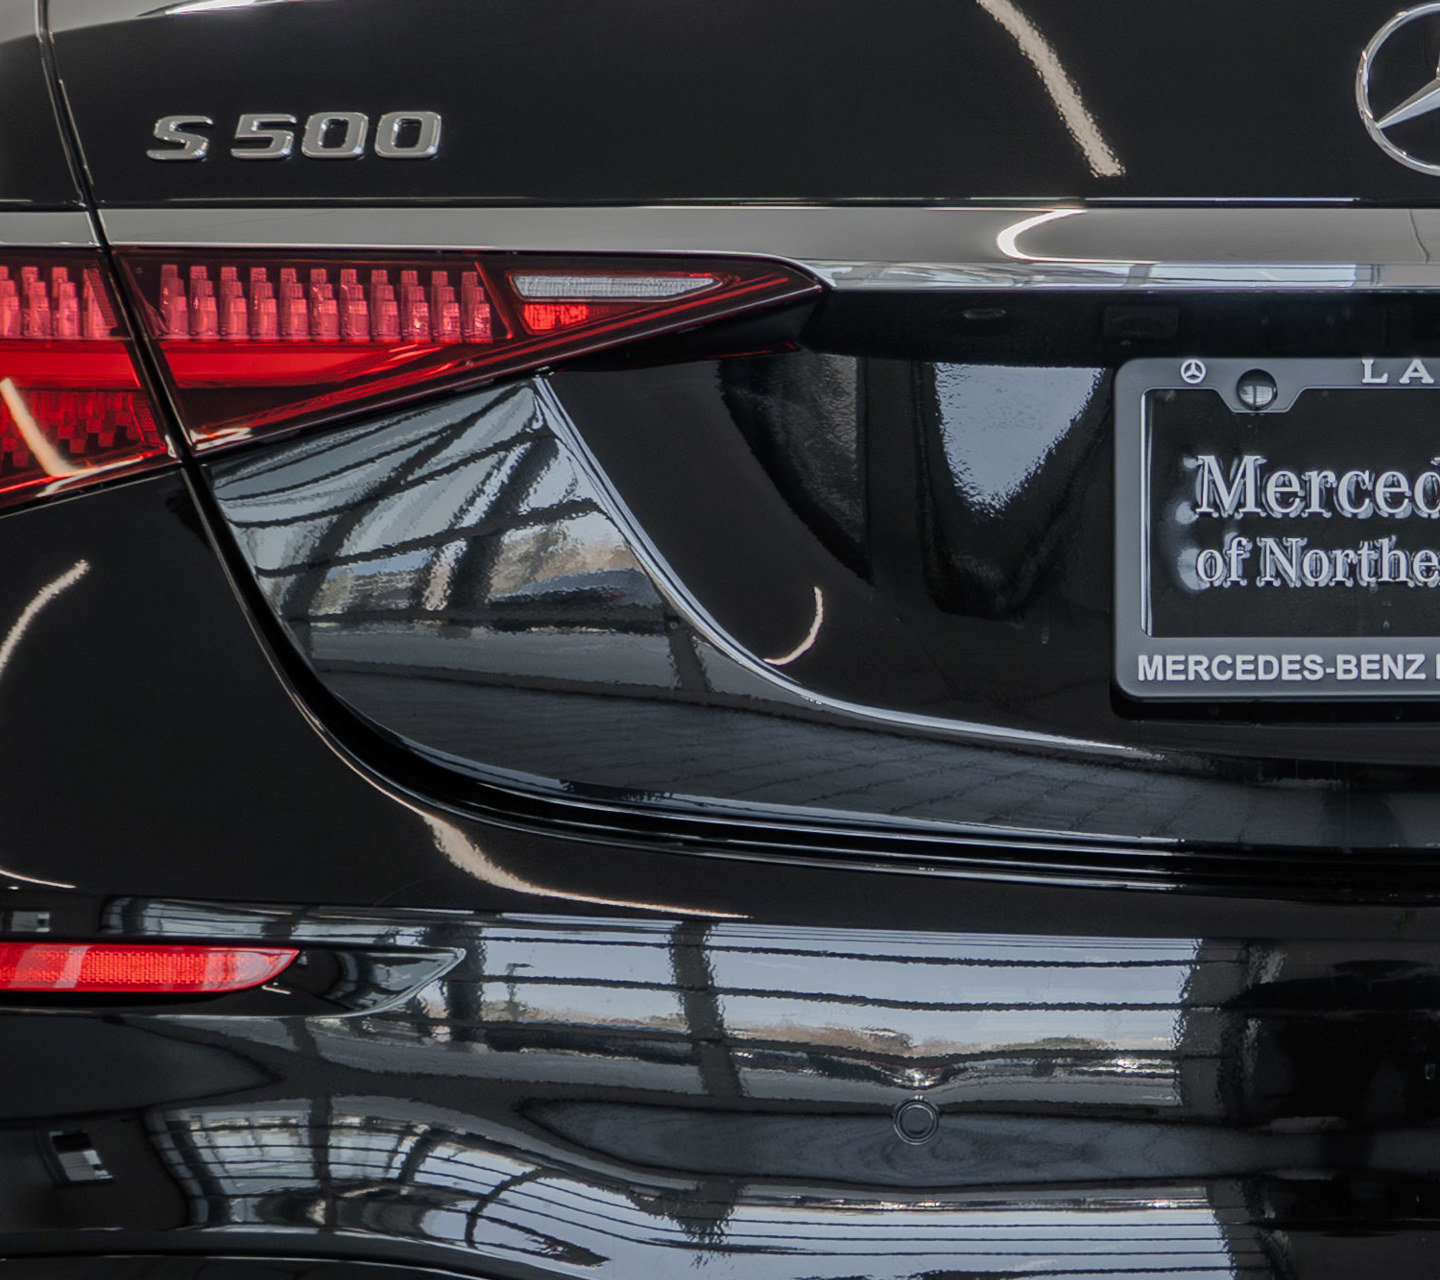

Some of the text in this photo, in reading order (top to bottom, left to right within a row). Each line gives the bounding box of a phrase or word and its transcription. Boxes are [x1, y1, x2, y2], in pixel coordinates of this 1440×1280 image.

[146, 111, 442, 160] S 500
[1195, 537, 1249, 586] of
[1137, 654, 1426, 681] MERCEDES-BENZ
